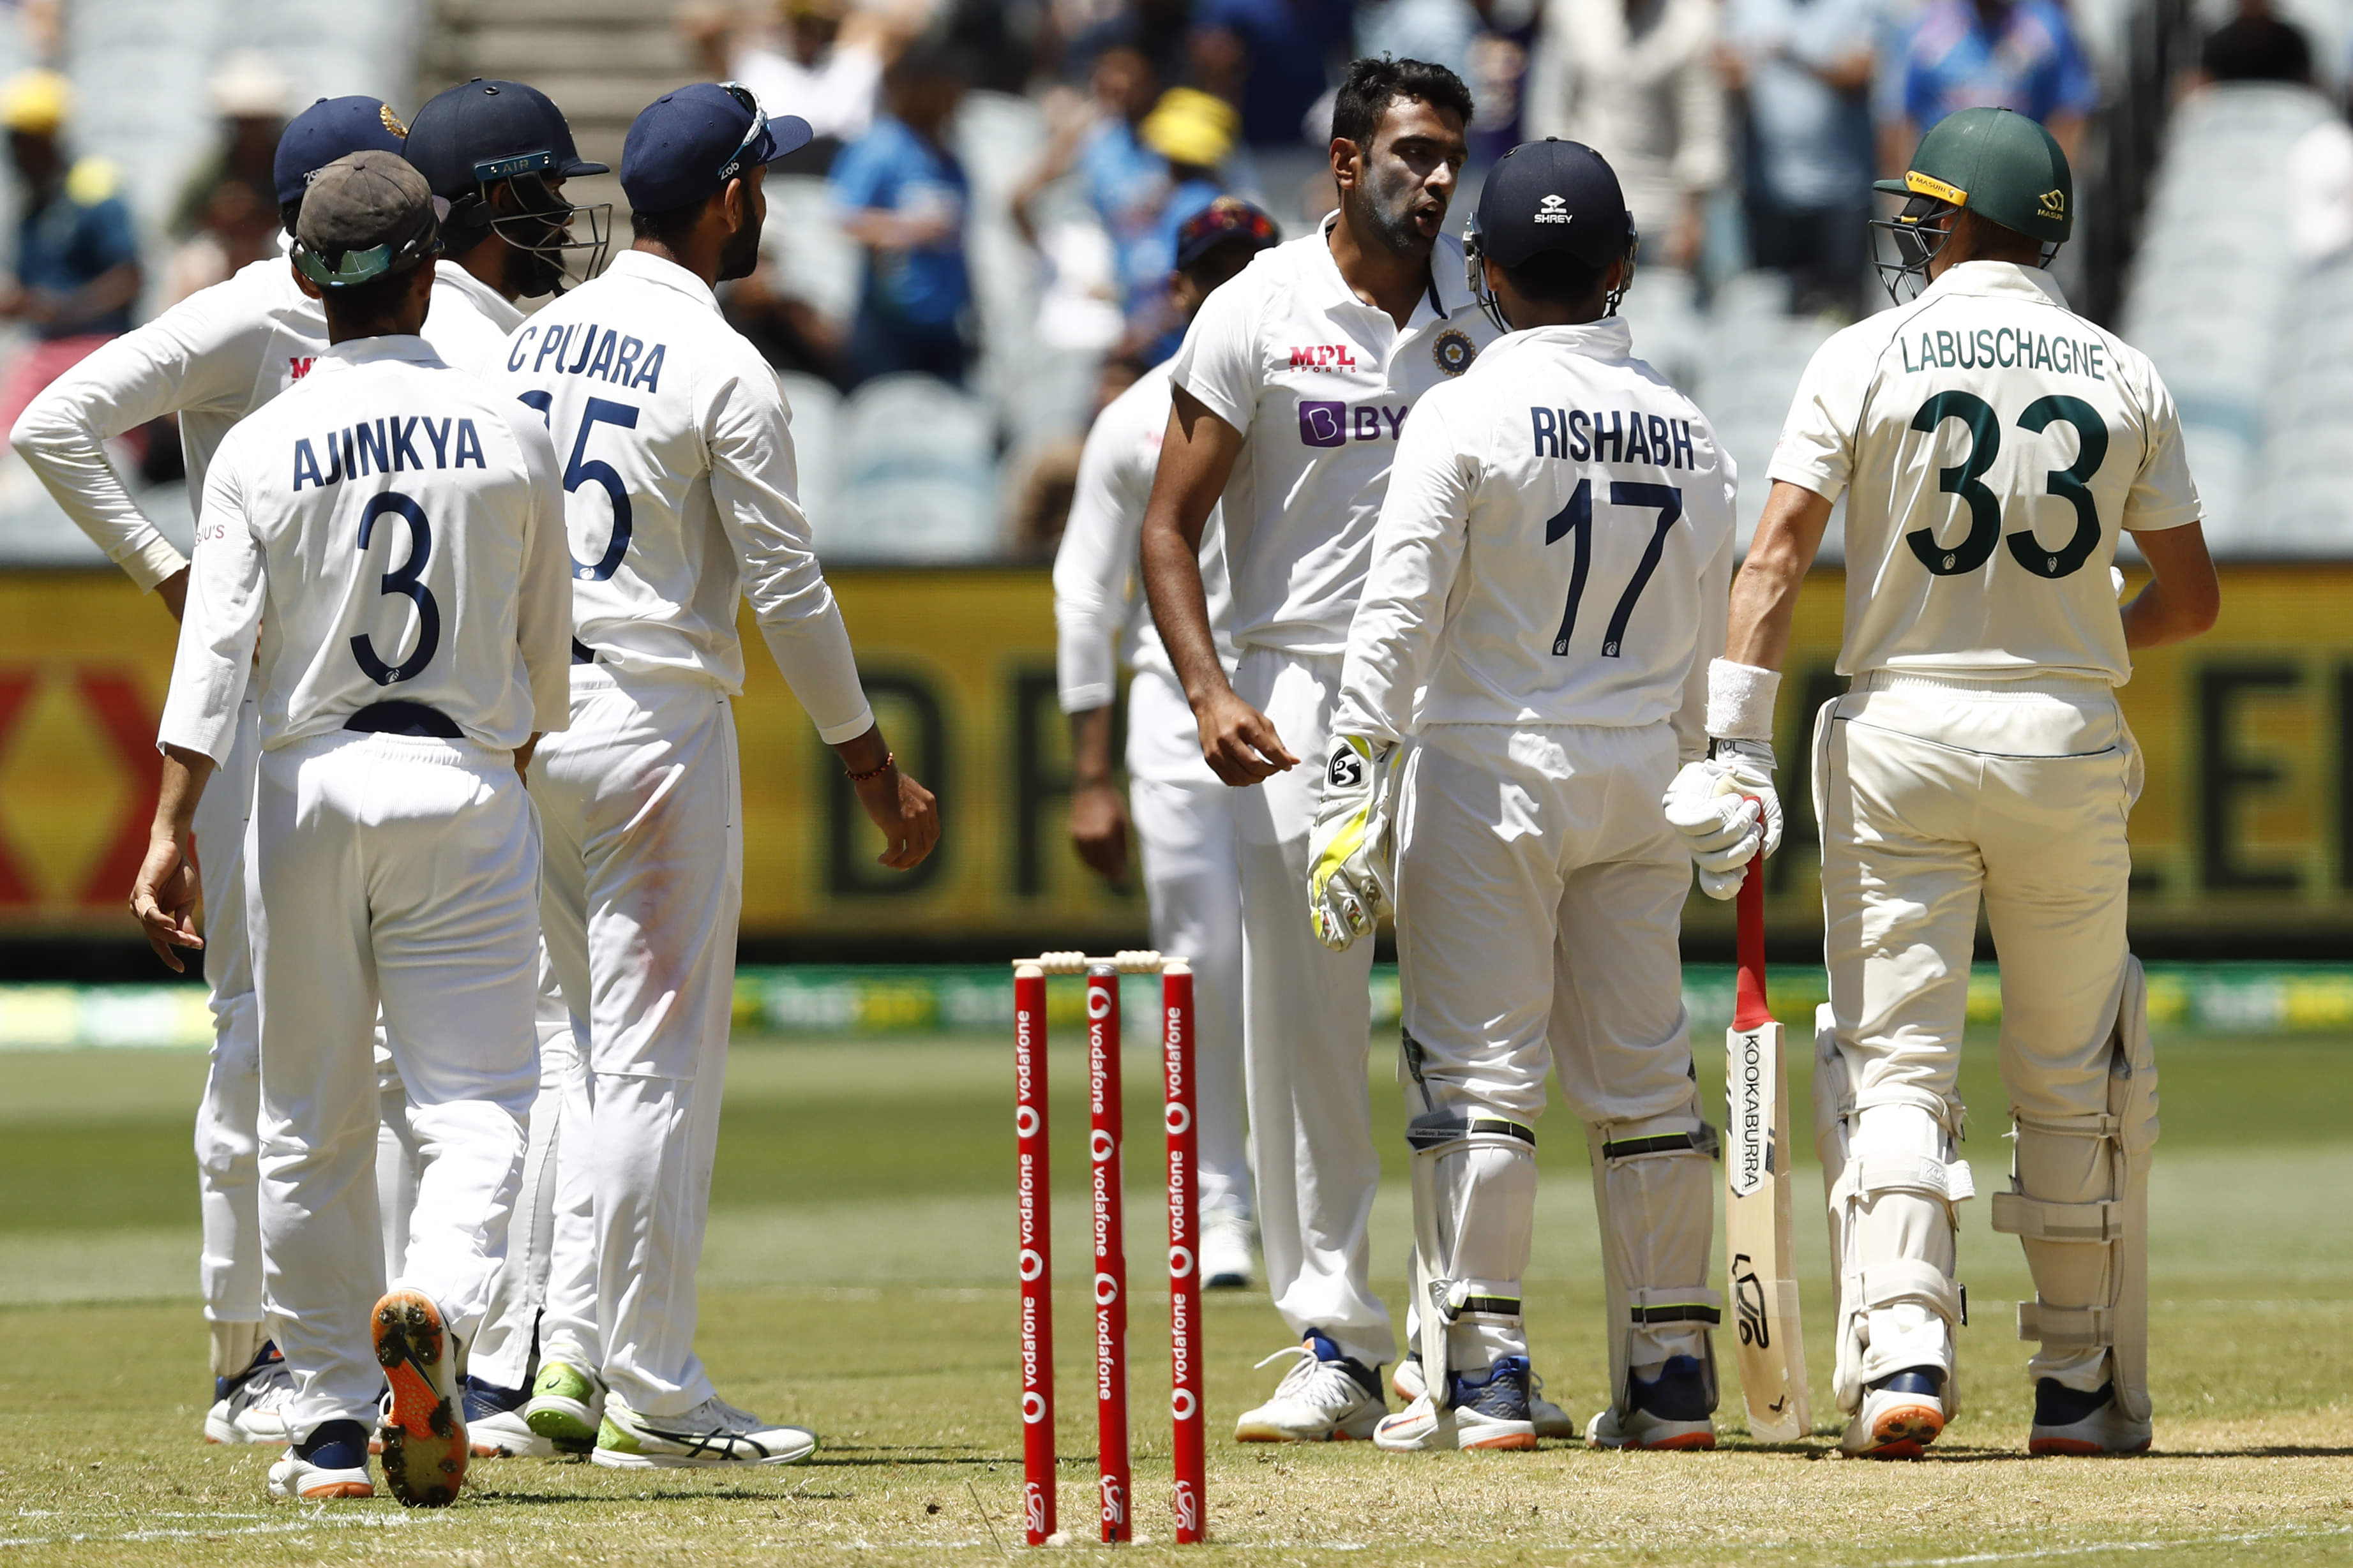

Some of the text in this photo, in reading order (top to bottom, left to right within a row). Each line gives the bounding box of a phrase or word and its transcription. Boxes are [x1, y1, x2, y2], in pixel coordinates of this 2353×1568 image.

[303, 167, 322, 185] 29
[1534, 214, 1573, 223] SHREY
[507, 323, 666, 394] C PUJARA
[1289, 345, 1356, 366] MPL
[1900, 327, 2105, 382] LABUSCHAGNE
[293, 415, 487, 492] AJINKYA
[1531, 407, 1695, 471] RISHABH
[1906, 390, 2109, 579] 33
[516, 389, 640, 581] 5
[350, 491, 440, 687] 3
[1545, 478, 1682, 659] 17
[1016, 1010, 1032, 1101] vodafone
[1090, 1024, 1108, 1115] vodafone
[1166, 1007, 1182, 1098] vodafone
[1743, 1034, 1760, 1188] KOOKABURRA
[1018, 1154, 1034, 1244] vodafone
[1094, 1165, 1111, 1257] vodafone
[1168, 1150, 1185, 1241] vodafone
[1021, 1296, 1037, 1388] vodafone
[1097, 1309, 1115, 1401] vodafone
[1171, 1292, 1187, 1384] vodafone
